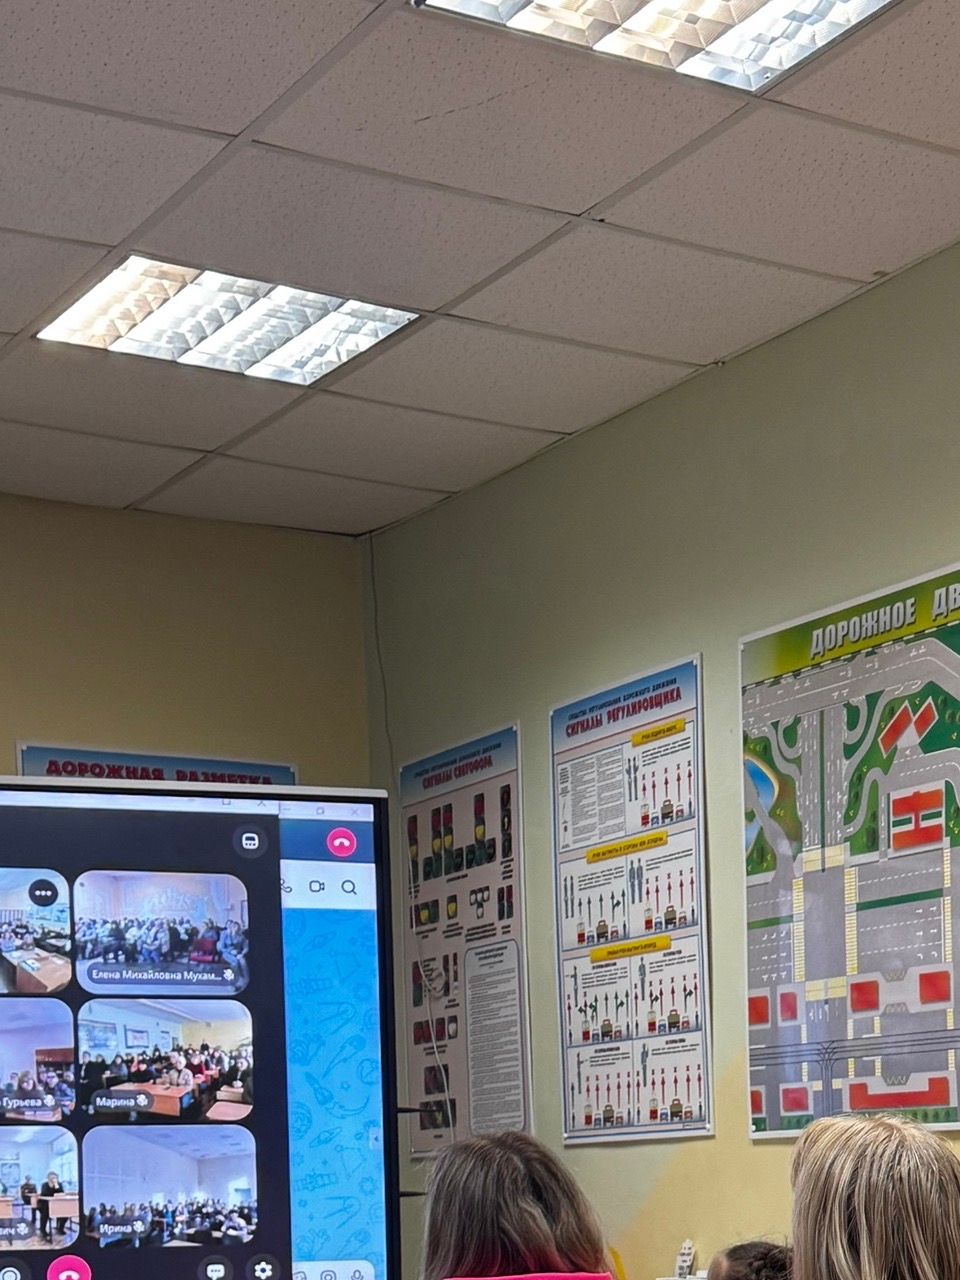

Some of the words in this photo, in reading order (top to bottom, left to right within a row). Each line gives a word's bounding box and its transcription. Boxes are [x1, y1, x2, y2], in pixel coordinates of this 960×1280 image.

[810, 597, 916, 657] ДОРОЖНОЕ
[566, 713, 603, 737] СИГНАЛЫ
[607, 686, 682, 724] РЕГУЛИРОВЩИКА
[46, 760, 165, 780] ДОРОЖНАЯ
[92, 969, 120, 979] Елена
[122, 969, 182, 980] Михайловна
[95, 1097, 135, 1108] Марина
[100, 1224, 133, 1235] Ирина
